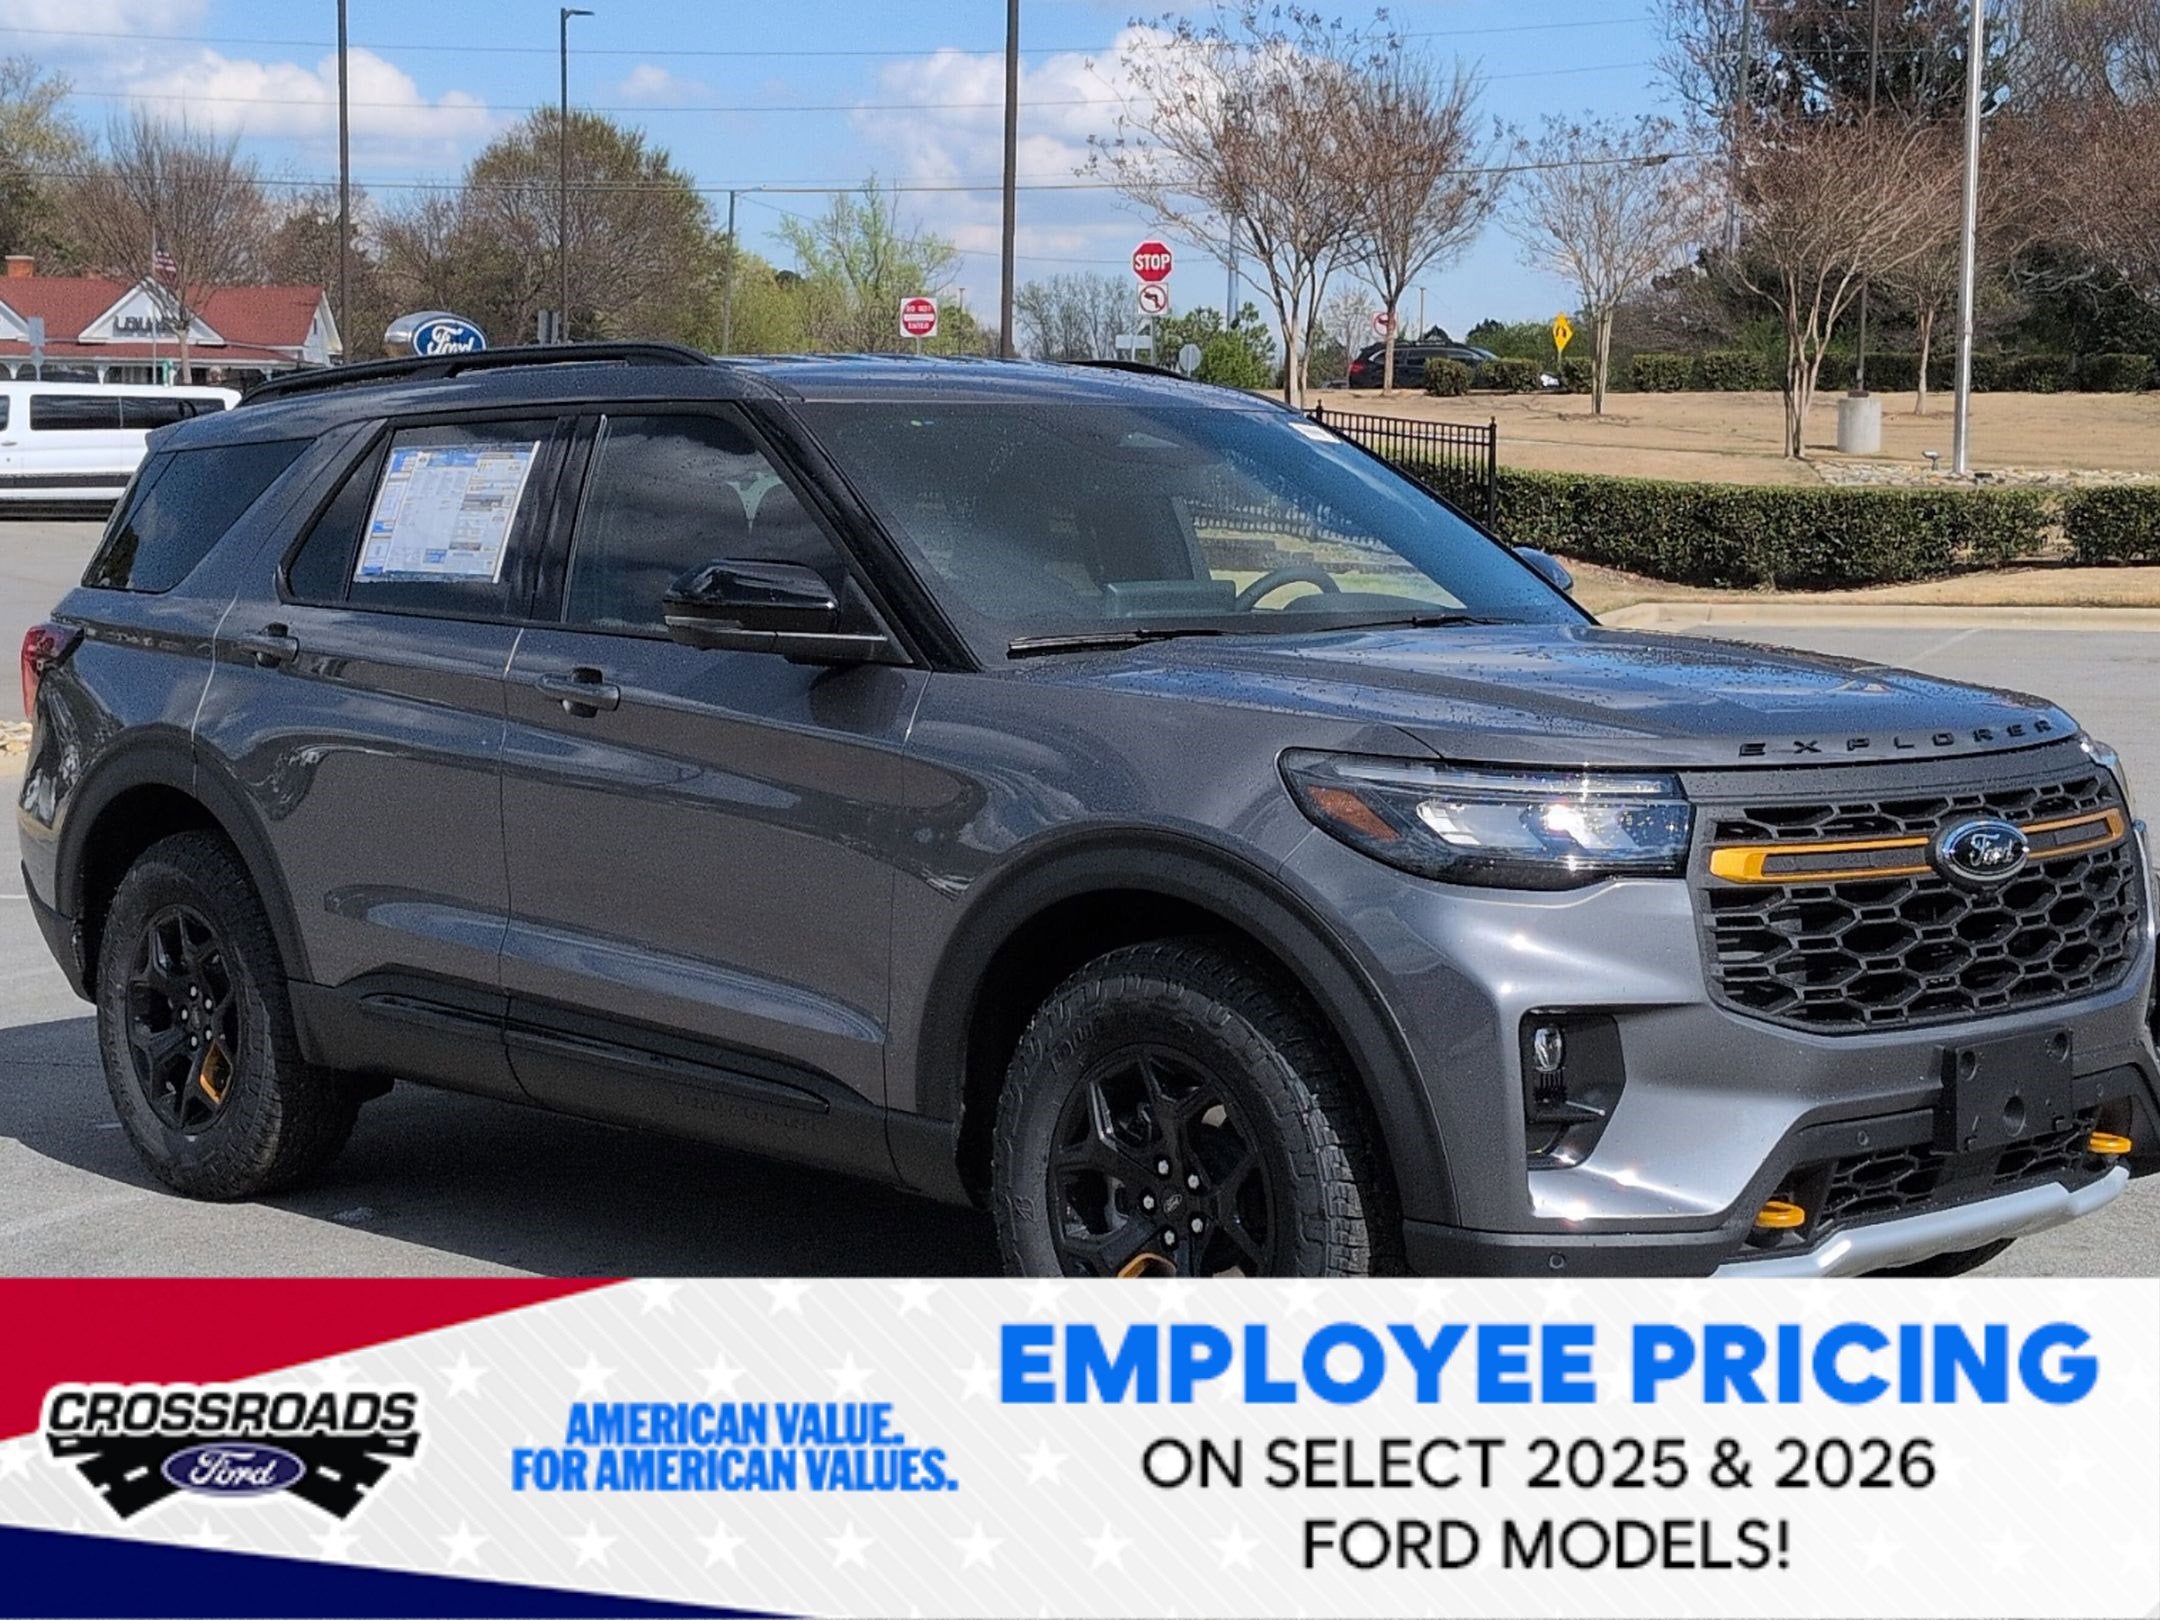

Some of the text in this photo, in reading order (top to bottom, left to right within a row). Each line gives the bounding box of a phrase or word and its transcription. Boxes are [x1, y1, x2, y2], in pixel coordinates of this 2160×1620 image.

[1135, 253, 1171, 271] STOP
[427, 325, 475, 355] Ford
[1739, 719, 2053, 757] EXPLORER
[1969, 833, 2014, 867] Ford
